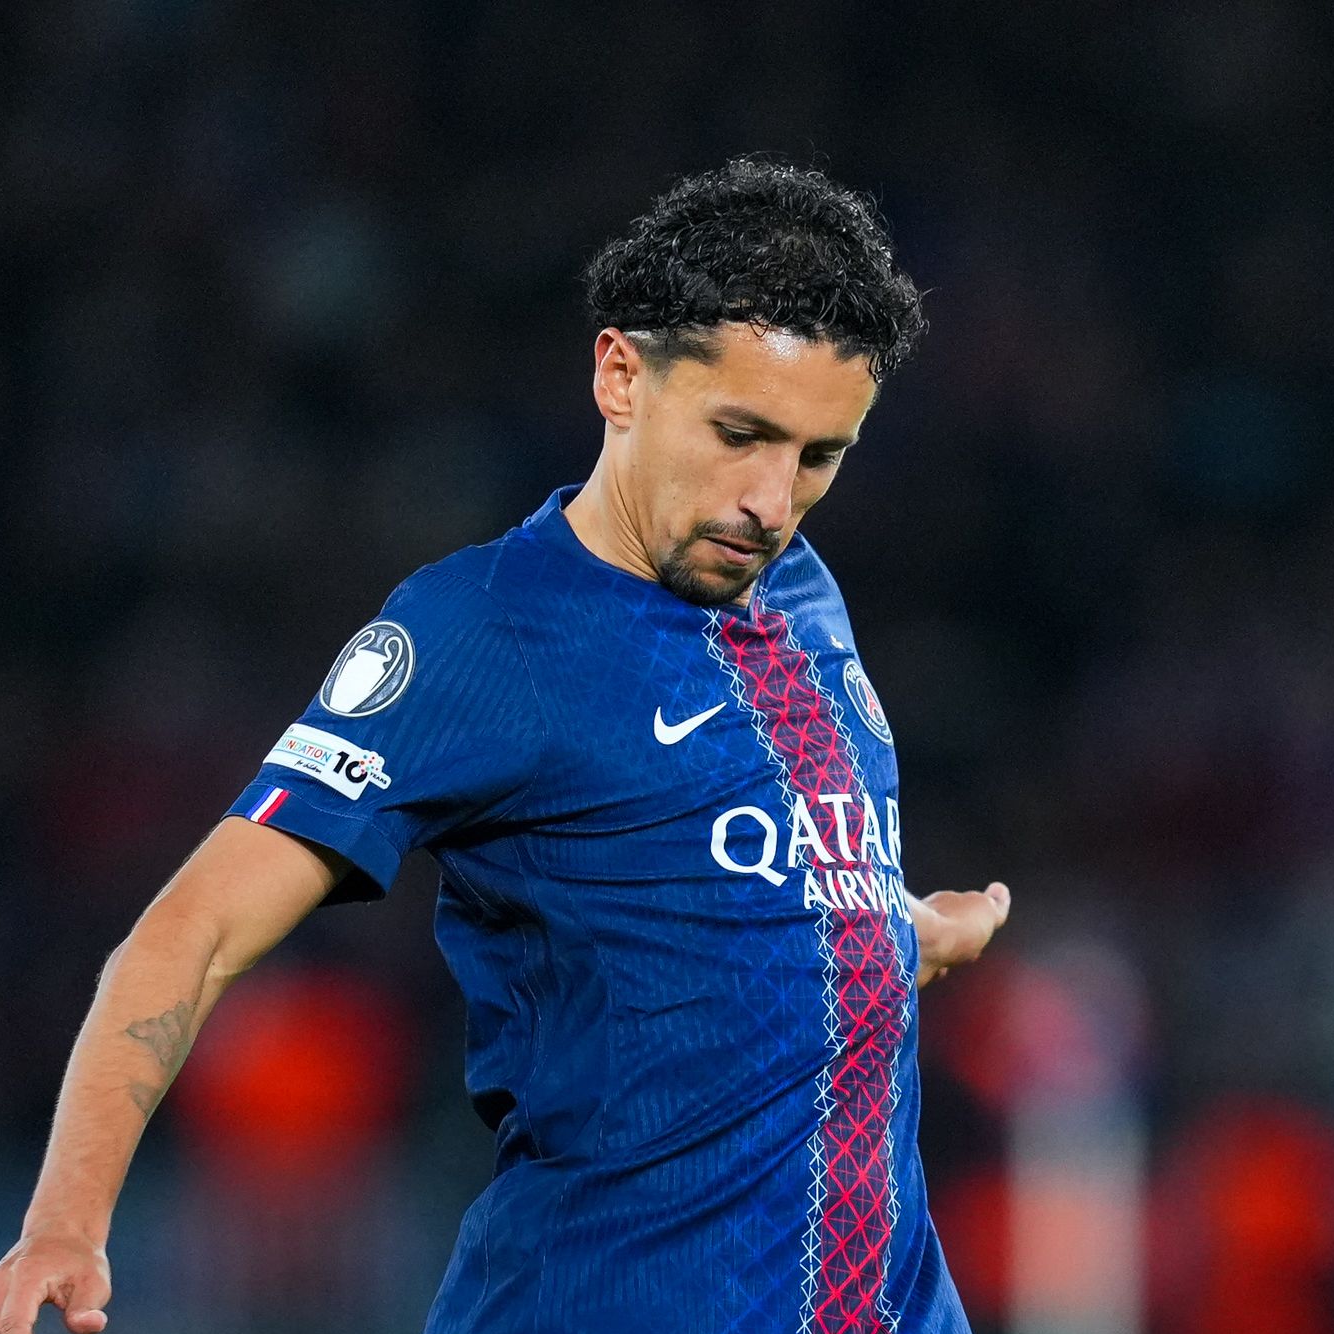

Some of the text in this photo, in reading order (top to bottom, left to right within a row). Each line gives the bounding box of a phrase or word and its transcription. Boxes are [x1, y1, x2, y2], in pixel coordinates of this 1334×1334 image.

[279, 737, 332, 762] UNDATION
[333, 751, 367, 783] 10
[370, 772, 387, 784] YEARS
[711, 793, 903, 886] QATAR
[804, 869, 913, 924] AIRWAY
